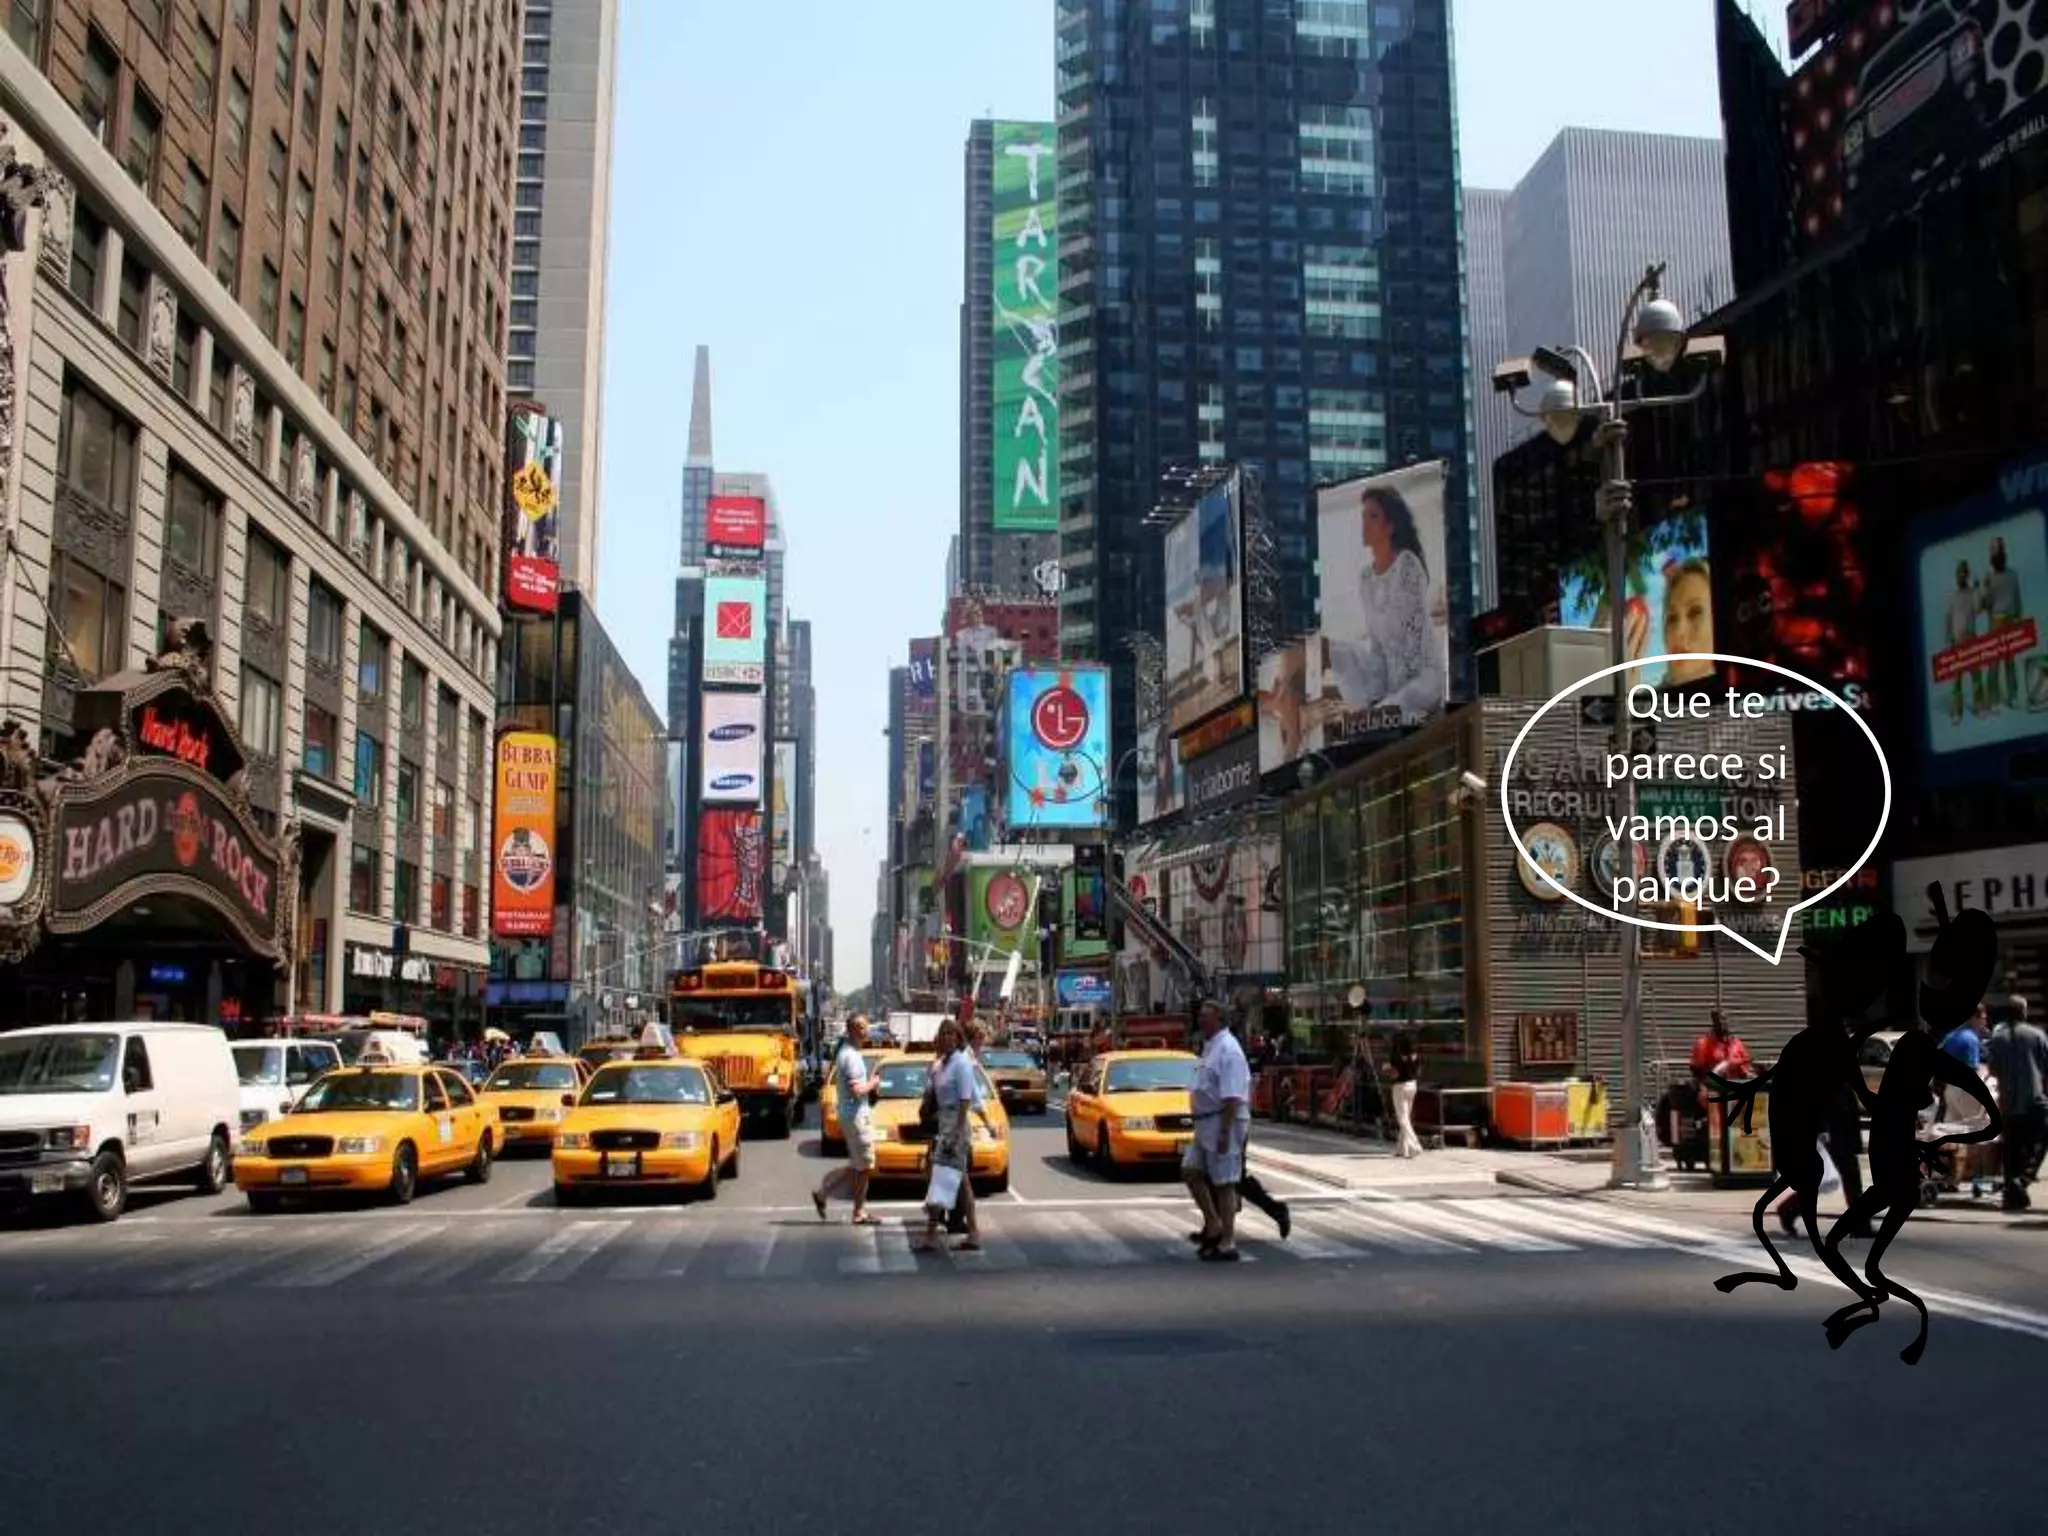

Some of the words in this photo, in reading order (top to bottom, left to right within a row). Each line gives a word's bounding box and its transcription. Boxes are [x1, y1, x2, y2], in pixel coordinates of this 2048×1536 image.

[1034, 689, 1086, 748] LG
[501, 741, 554, 765] BUBBA
[505, 768, 550, 791] GUMP
[62, 797, 159, 880] HARD
[210, 819, 270, 917] ROCK
